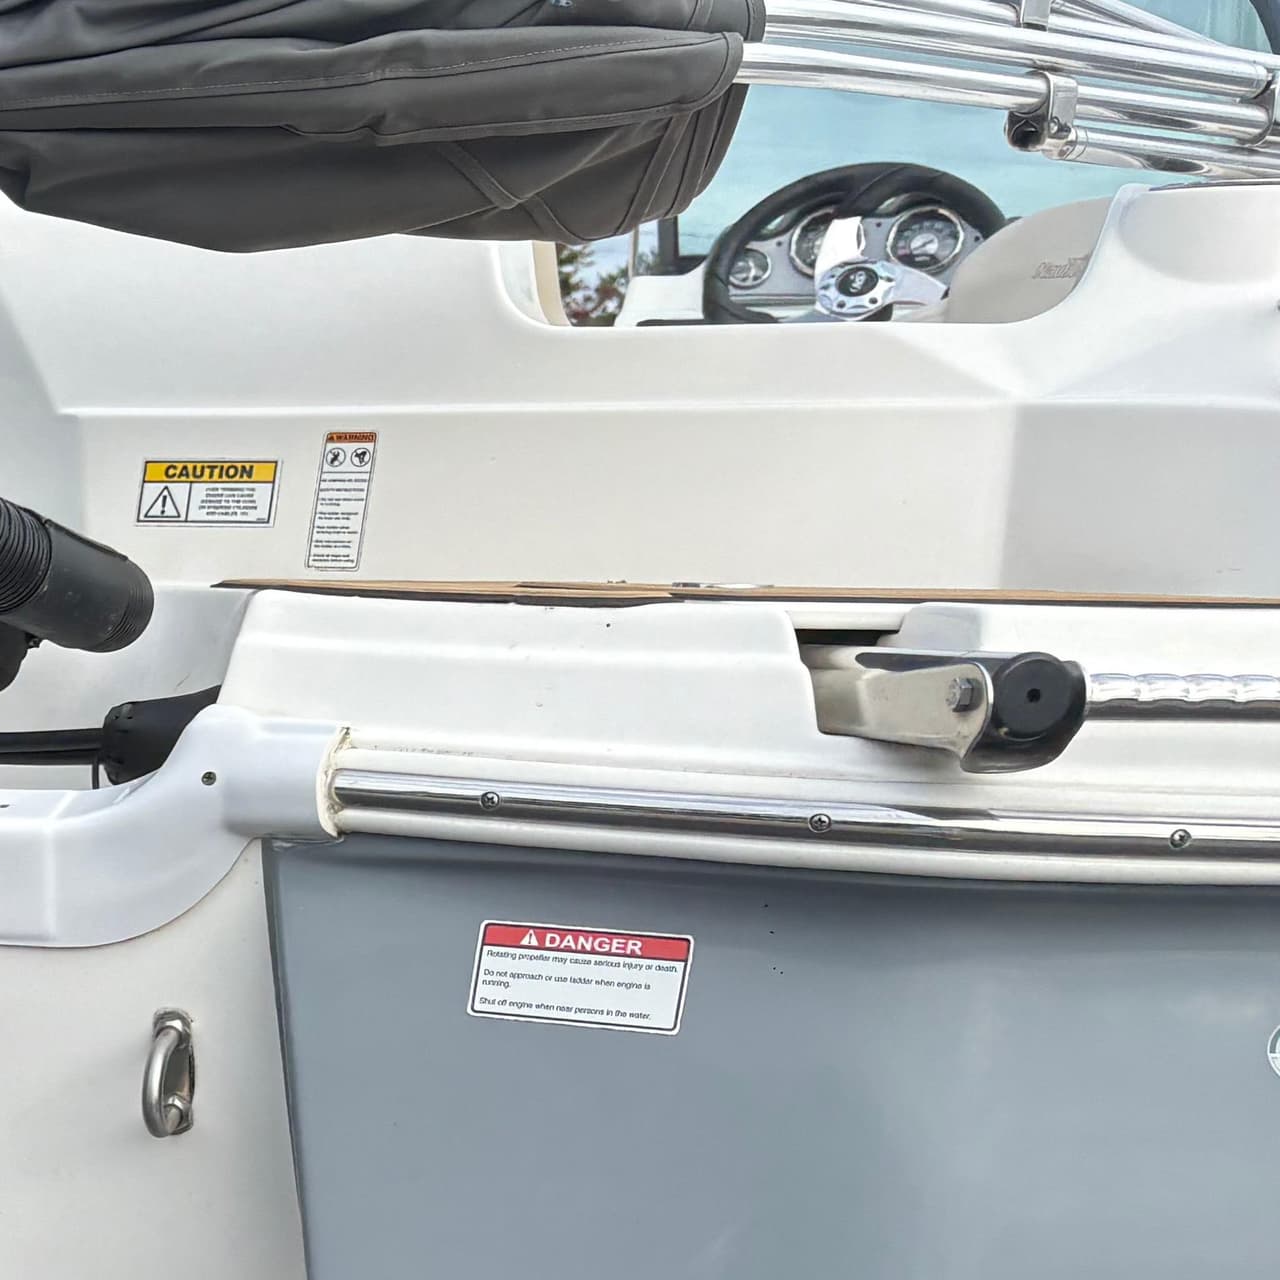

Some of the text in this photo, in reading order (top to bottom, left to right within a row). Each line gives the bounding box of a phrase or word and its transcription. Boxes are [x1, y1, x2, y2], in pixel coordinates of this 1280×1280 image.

[163, 464, 254, 480] CAUTION
[544, 933, 643, 956] DANGER
[487, 950, 517, 960] Rotating
[518, 952, 550, 962] propeller
[552, 956, 568, 965] may
[593, 960, 621, 968] serious
[622, 961, 644, 971] injury
[484, 968, 495, 976] Do
[509, 971, 543, 981] approach
[570, 976, 593, 985] ladder
[595, 979, 615, 987] when
[617, 981, 643, 990] engine
[479, 997, 497, 1006] Shut
[508, 1000, 533, 1010] engine
[535, 1003, 555, 1011] when
[556, 1005, 573, 1013] near
[574, 1006, 605, 1016] persons
[614, 1009, 627, 1017] the
